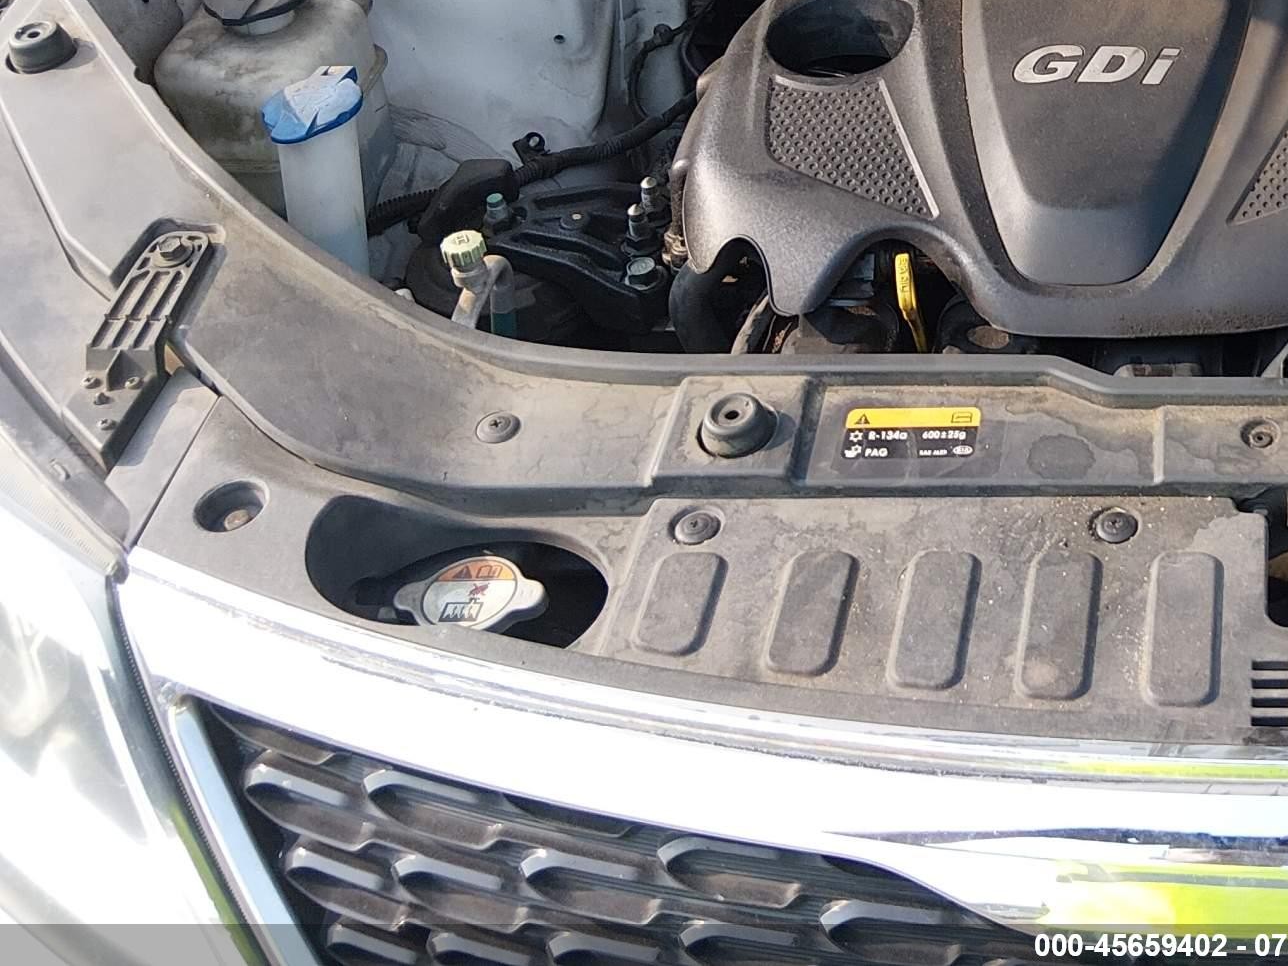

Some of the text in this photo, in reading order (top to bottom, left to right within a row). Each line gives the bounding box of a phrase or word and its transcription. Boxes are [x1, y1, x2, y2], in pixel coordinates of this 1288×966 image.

[1012, 43, 1182, 85] GDi
[867, 430, 908, 442] R-134a
[864, 447, 889, 457] PAG
